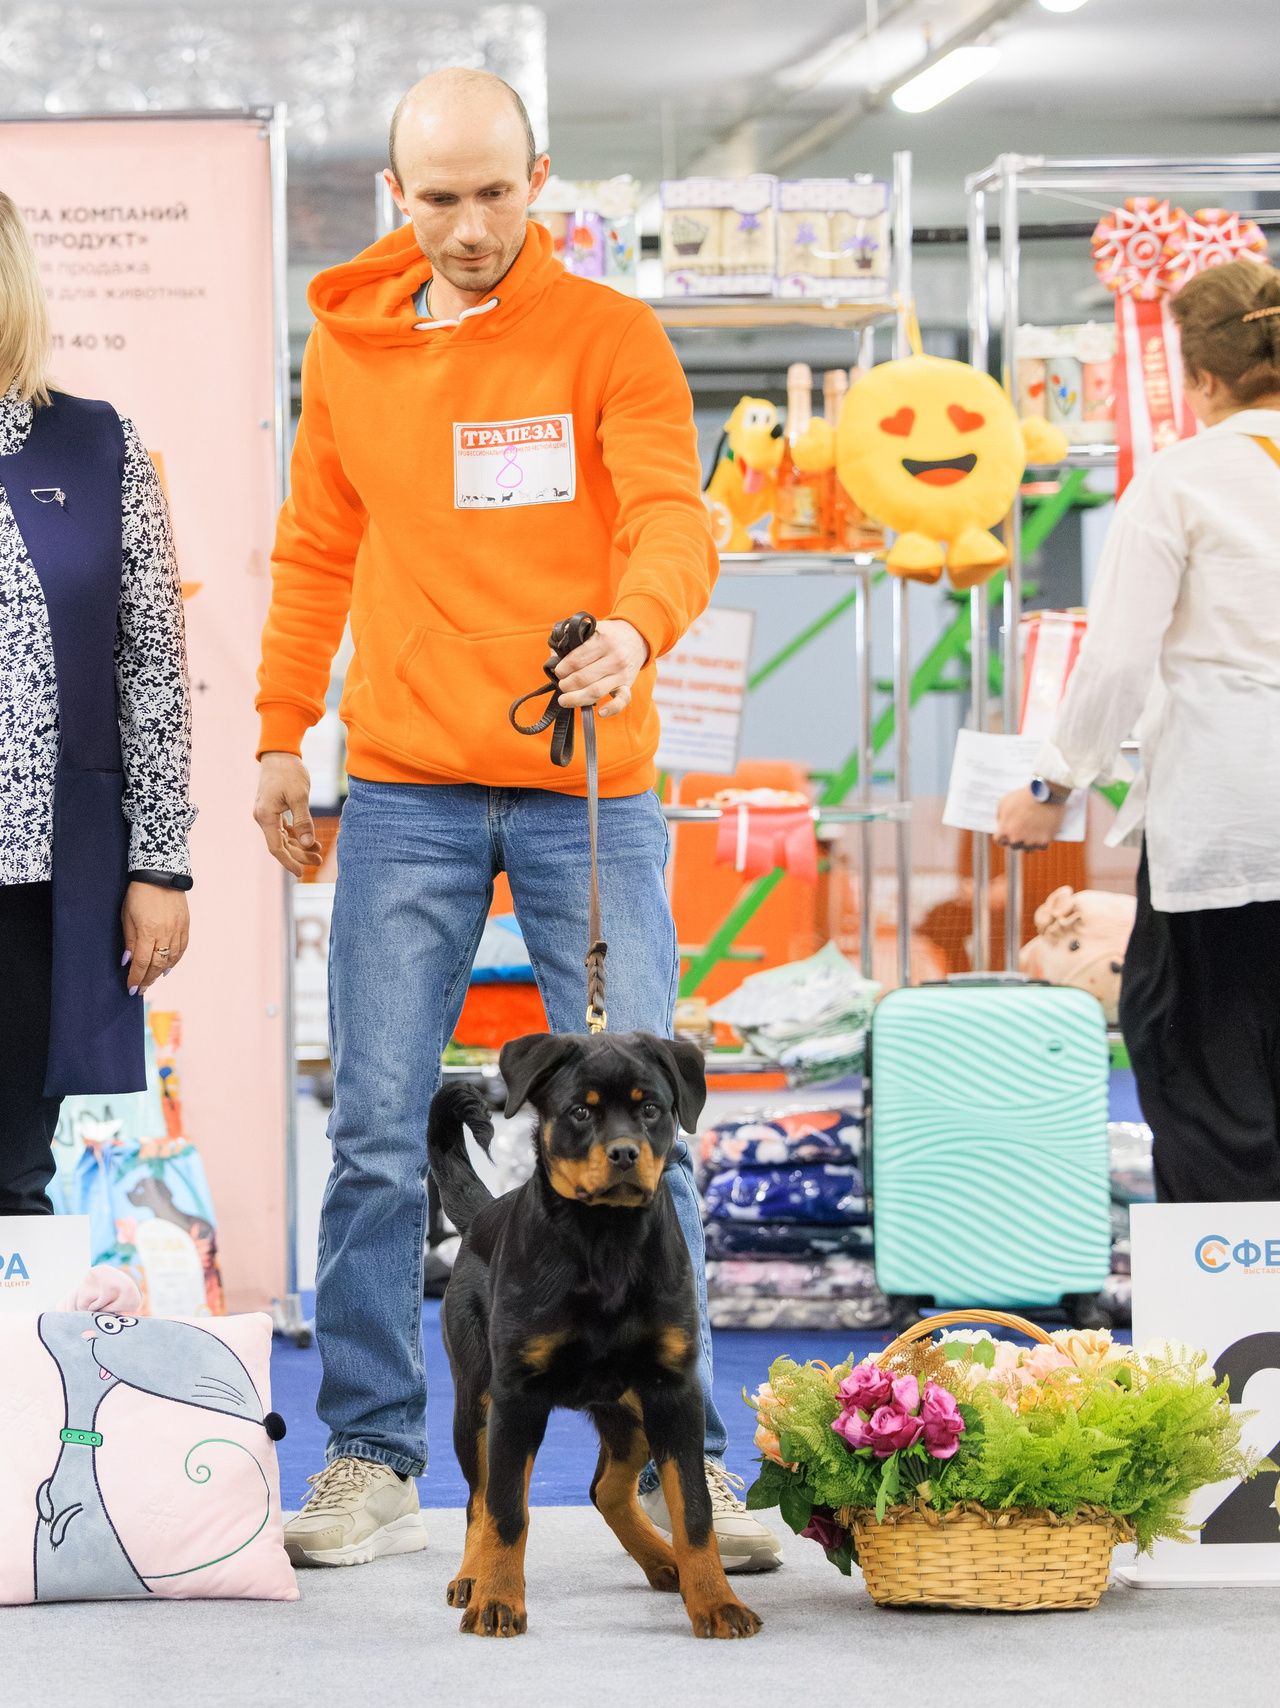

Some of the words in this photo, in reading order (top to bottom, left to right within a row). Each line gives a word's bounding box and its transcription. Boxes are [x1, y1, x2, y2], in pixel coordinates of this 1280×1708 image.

[60, 202, 189, 223] КОМПАНИЙ
[57, 262, 151, 276] продажа
[71, 334, 98, 349] 40
[104, 334, 126, 350] 10
[463, 423, 560, 447] ТРАПЕЗА
[496, 445, 523, 488] 8
[1194, 1234, 1280, 1274] СФЕ
[4, 1280, 31, 1289] ЦЕНТР
